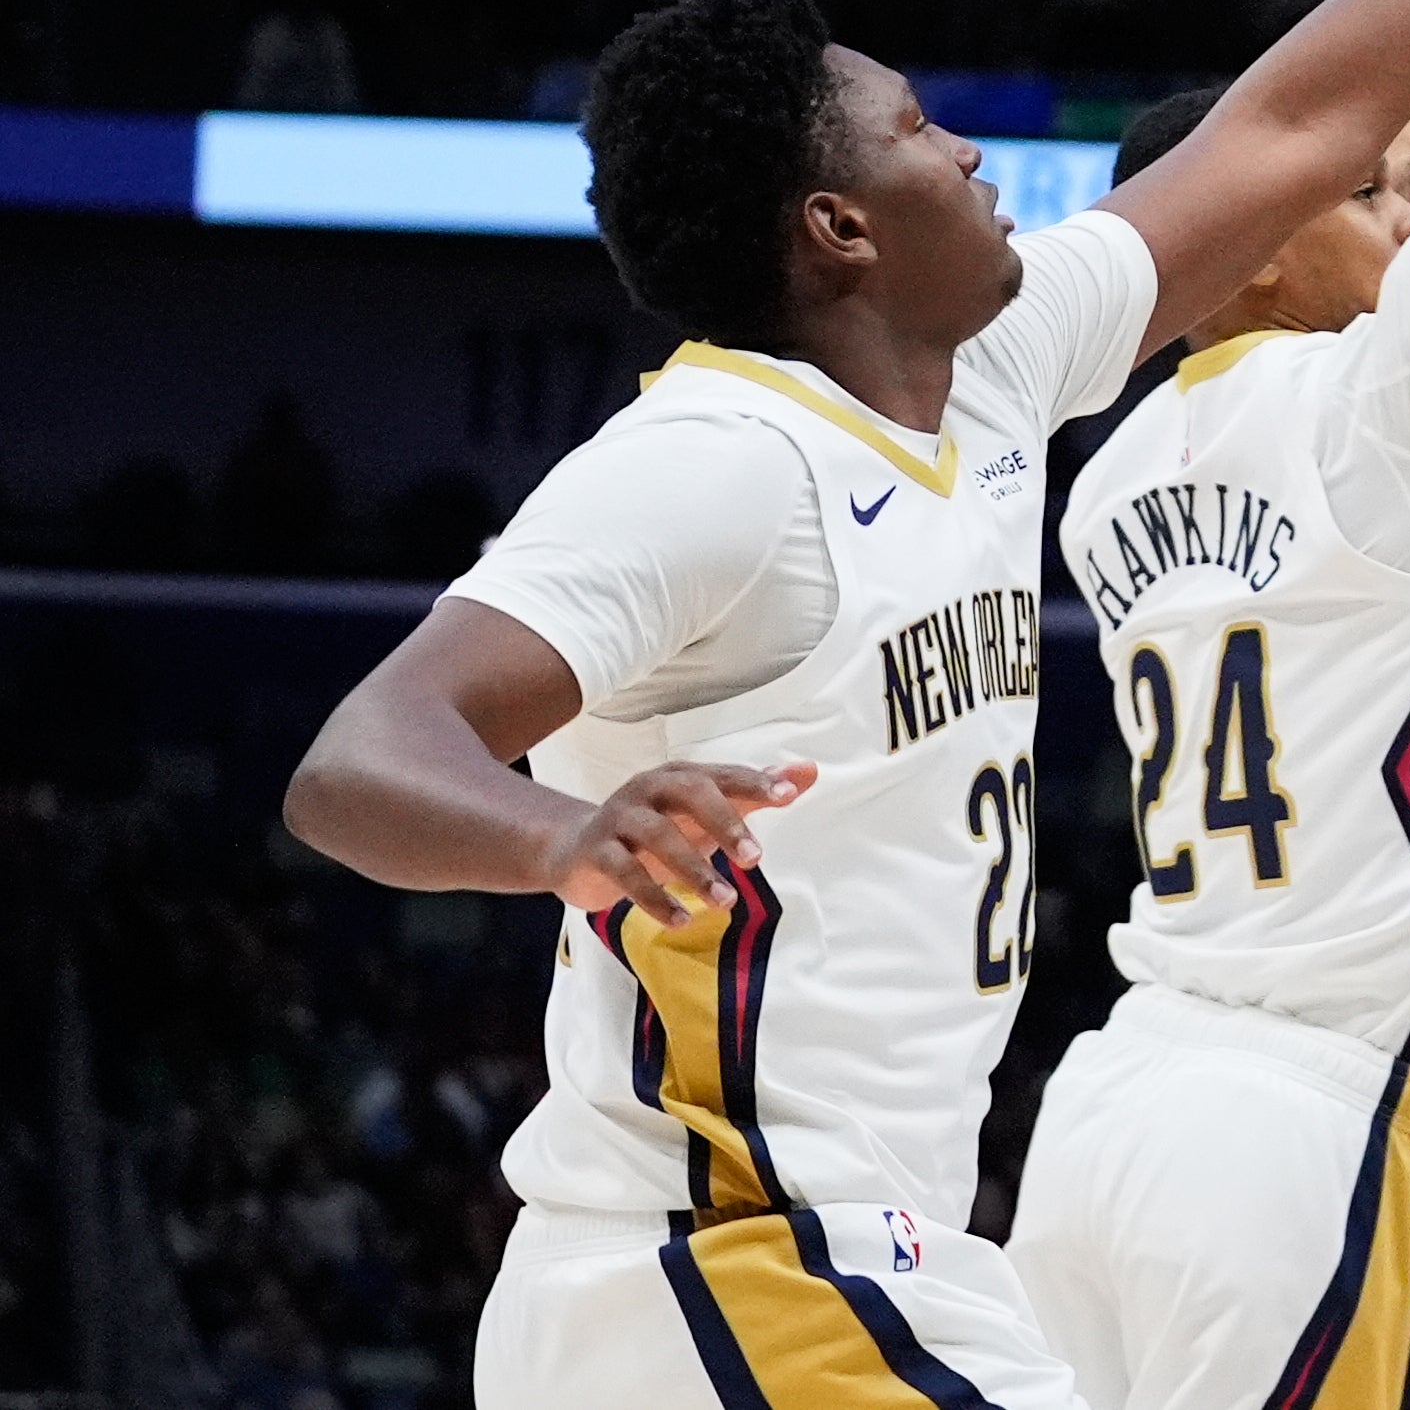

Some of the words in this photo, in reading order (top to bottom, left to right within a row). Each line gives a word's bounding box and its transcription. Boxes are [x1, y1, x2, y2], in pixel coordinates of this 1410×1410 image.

[1087, 483, 1295, 631] HAWKINS
[879, 596, 976, 755] NEW
[1123, 621, 1298, 904] 24
[966, 750, 1037, 996] 22
